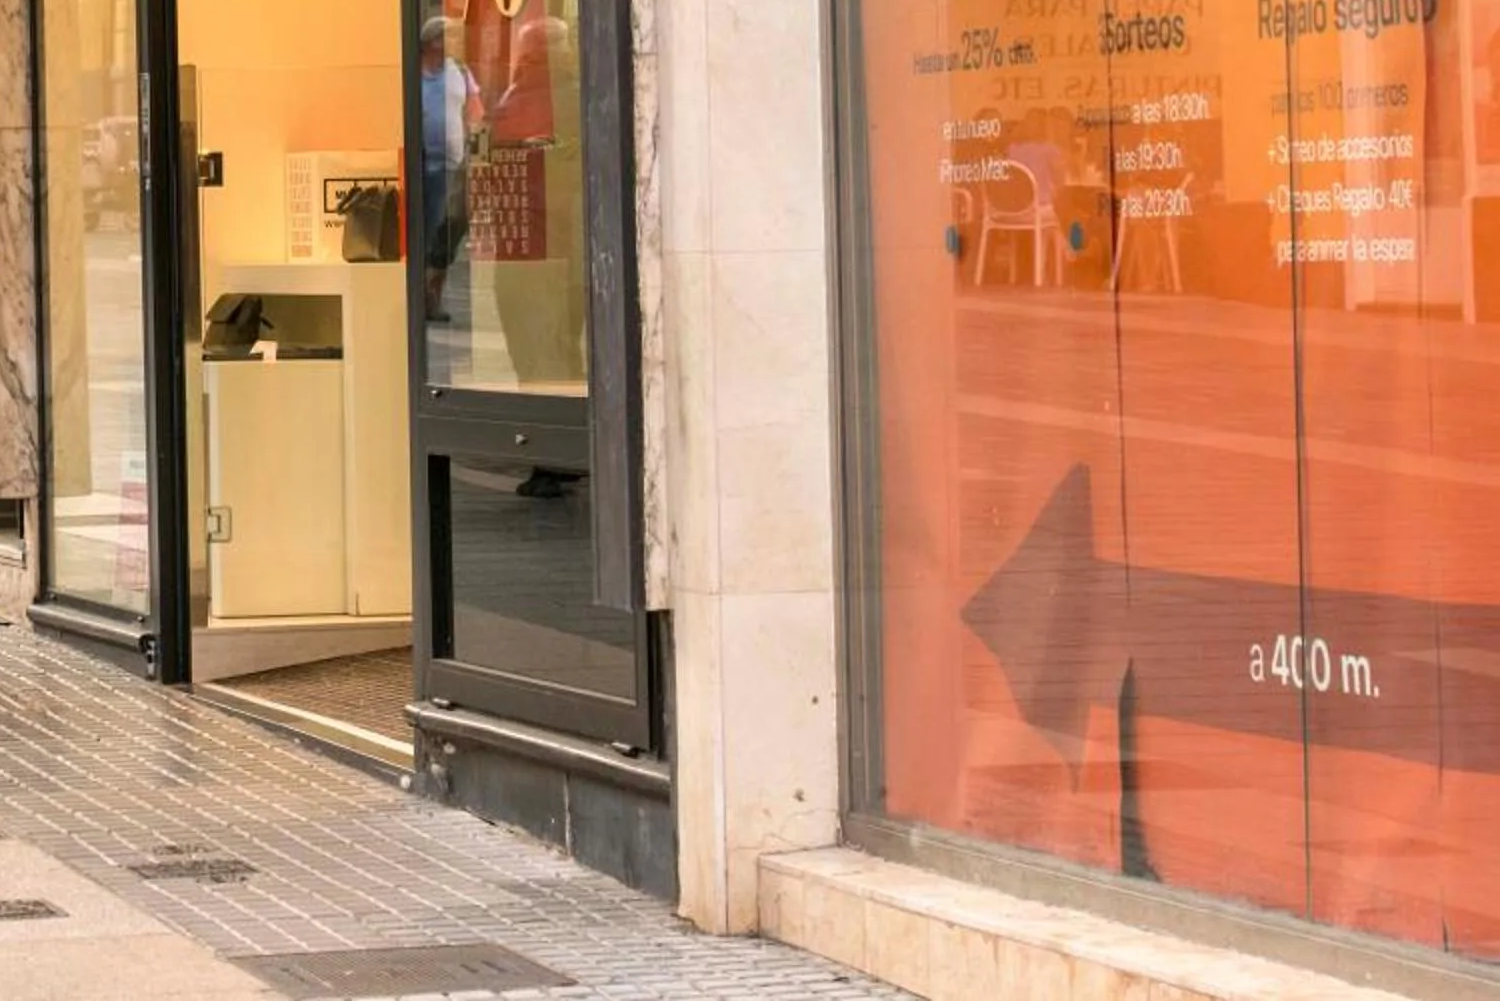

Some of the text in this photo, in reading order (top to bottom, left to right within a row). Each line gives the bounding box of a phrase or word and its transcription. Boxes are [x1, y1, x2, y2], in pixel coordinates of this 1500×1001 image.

[1249, 634, 1381, 698] a 400 m.
